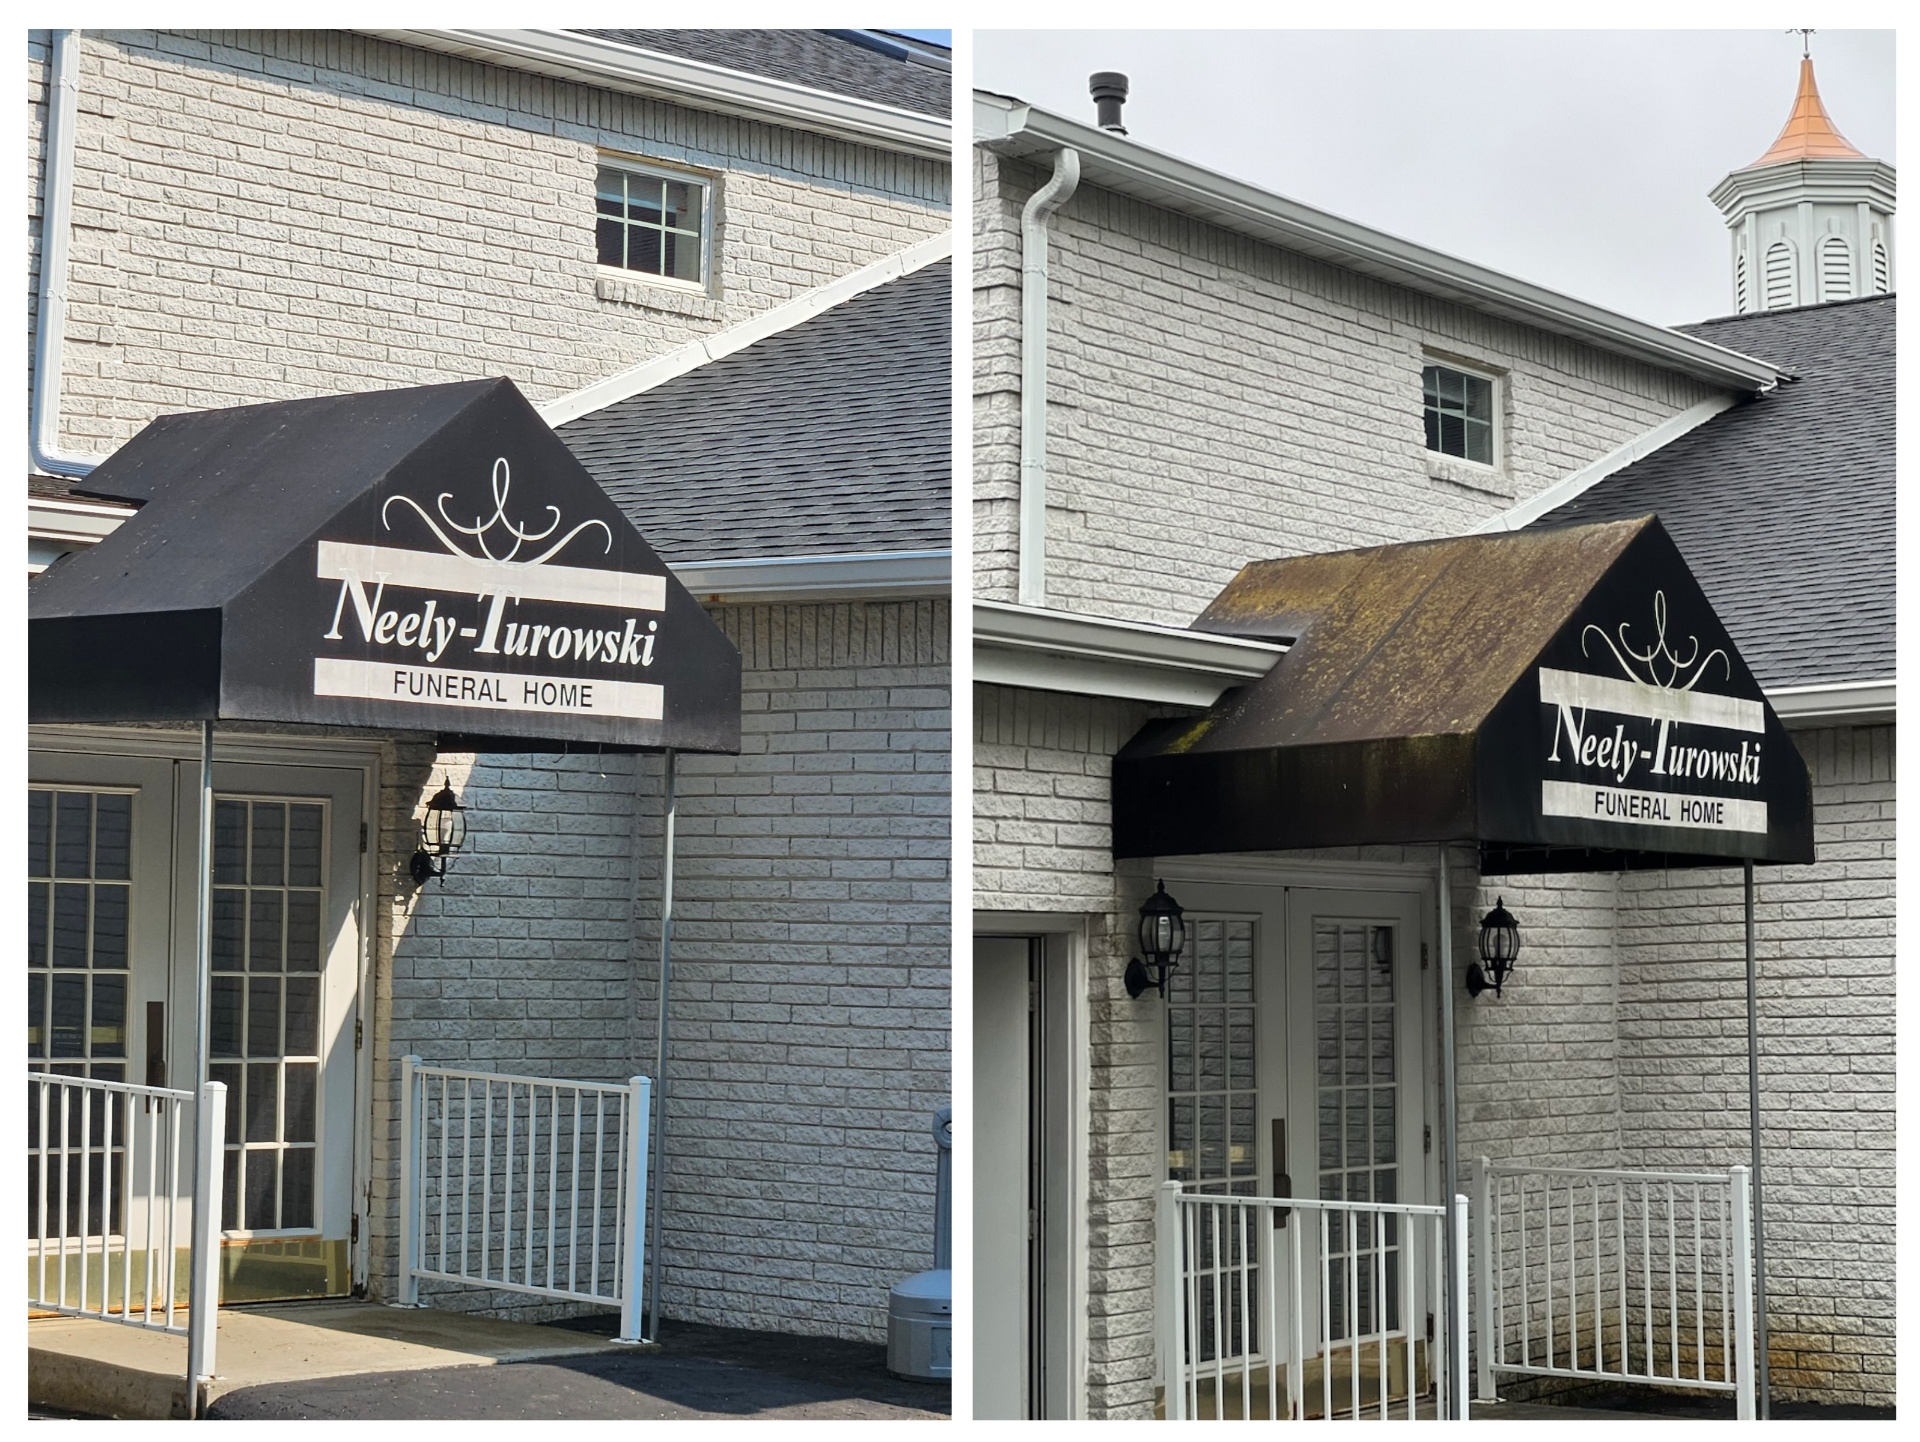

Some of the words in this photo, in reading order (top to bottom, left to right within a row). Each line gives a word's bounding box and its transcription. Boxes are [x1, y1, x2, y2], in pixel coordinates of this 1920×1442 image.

[323, 567, 658, 667] Neely-Turowski
[393, 670, 508, 703] FUNERAL
[523, 680, 594, 708] HOME
[1547, 693, 1762, 785] Neely-Turowski
[1594, 791, 1671, 821] FUNERAL
[1680, 800, 1724, 825] HOME
